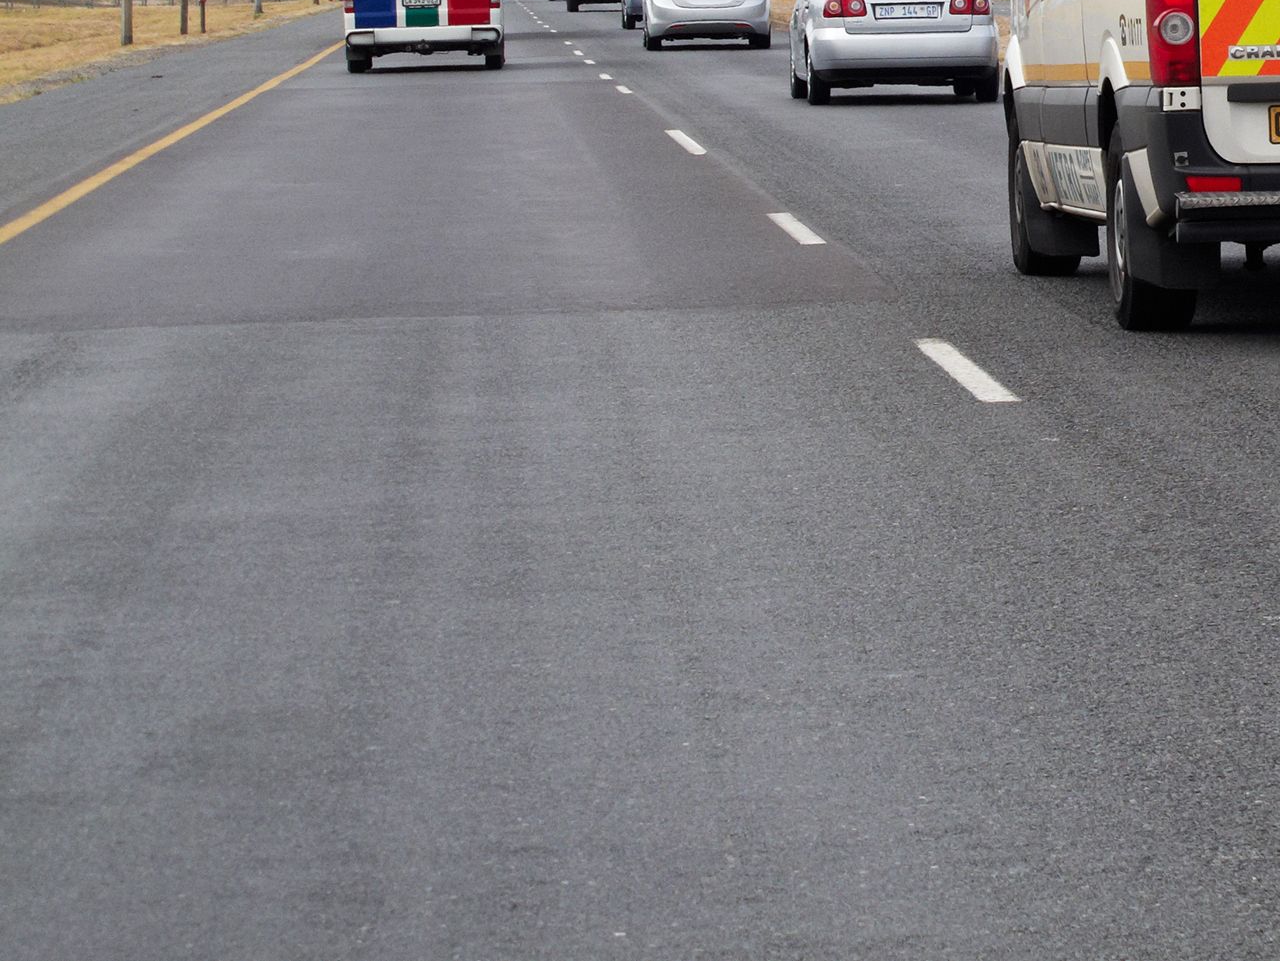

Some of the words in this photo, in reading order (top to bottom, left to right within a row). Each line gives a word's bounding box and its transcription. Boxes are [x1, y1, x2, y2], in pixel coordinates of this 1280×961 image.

[880, 7, 895, 17] ZNP
[902, 6, 918, 16] 144
[926, 5, 937, 16] GP
